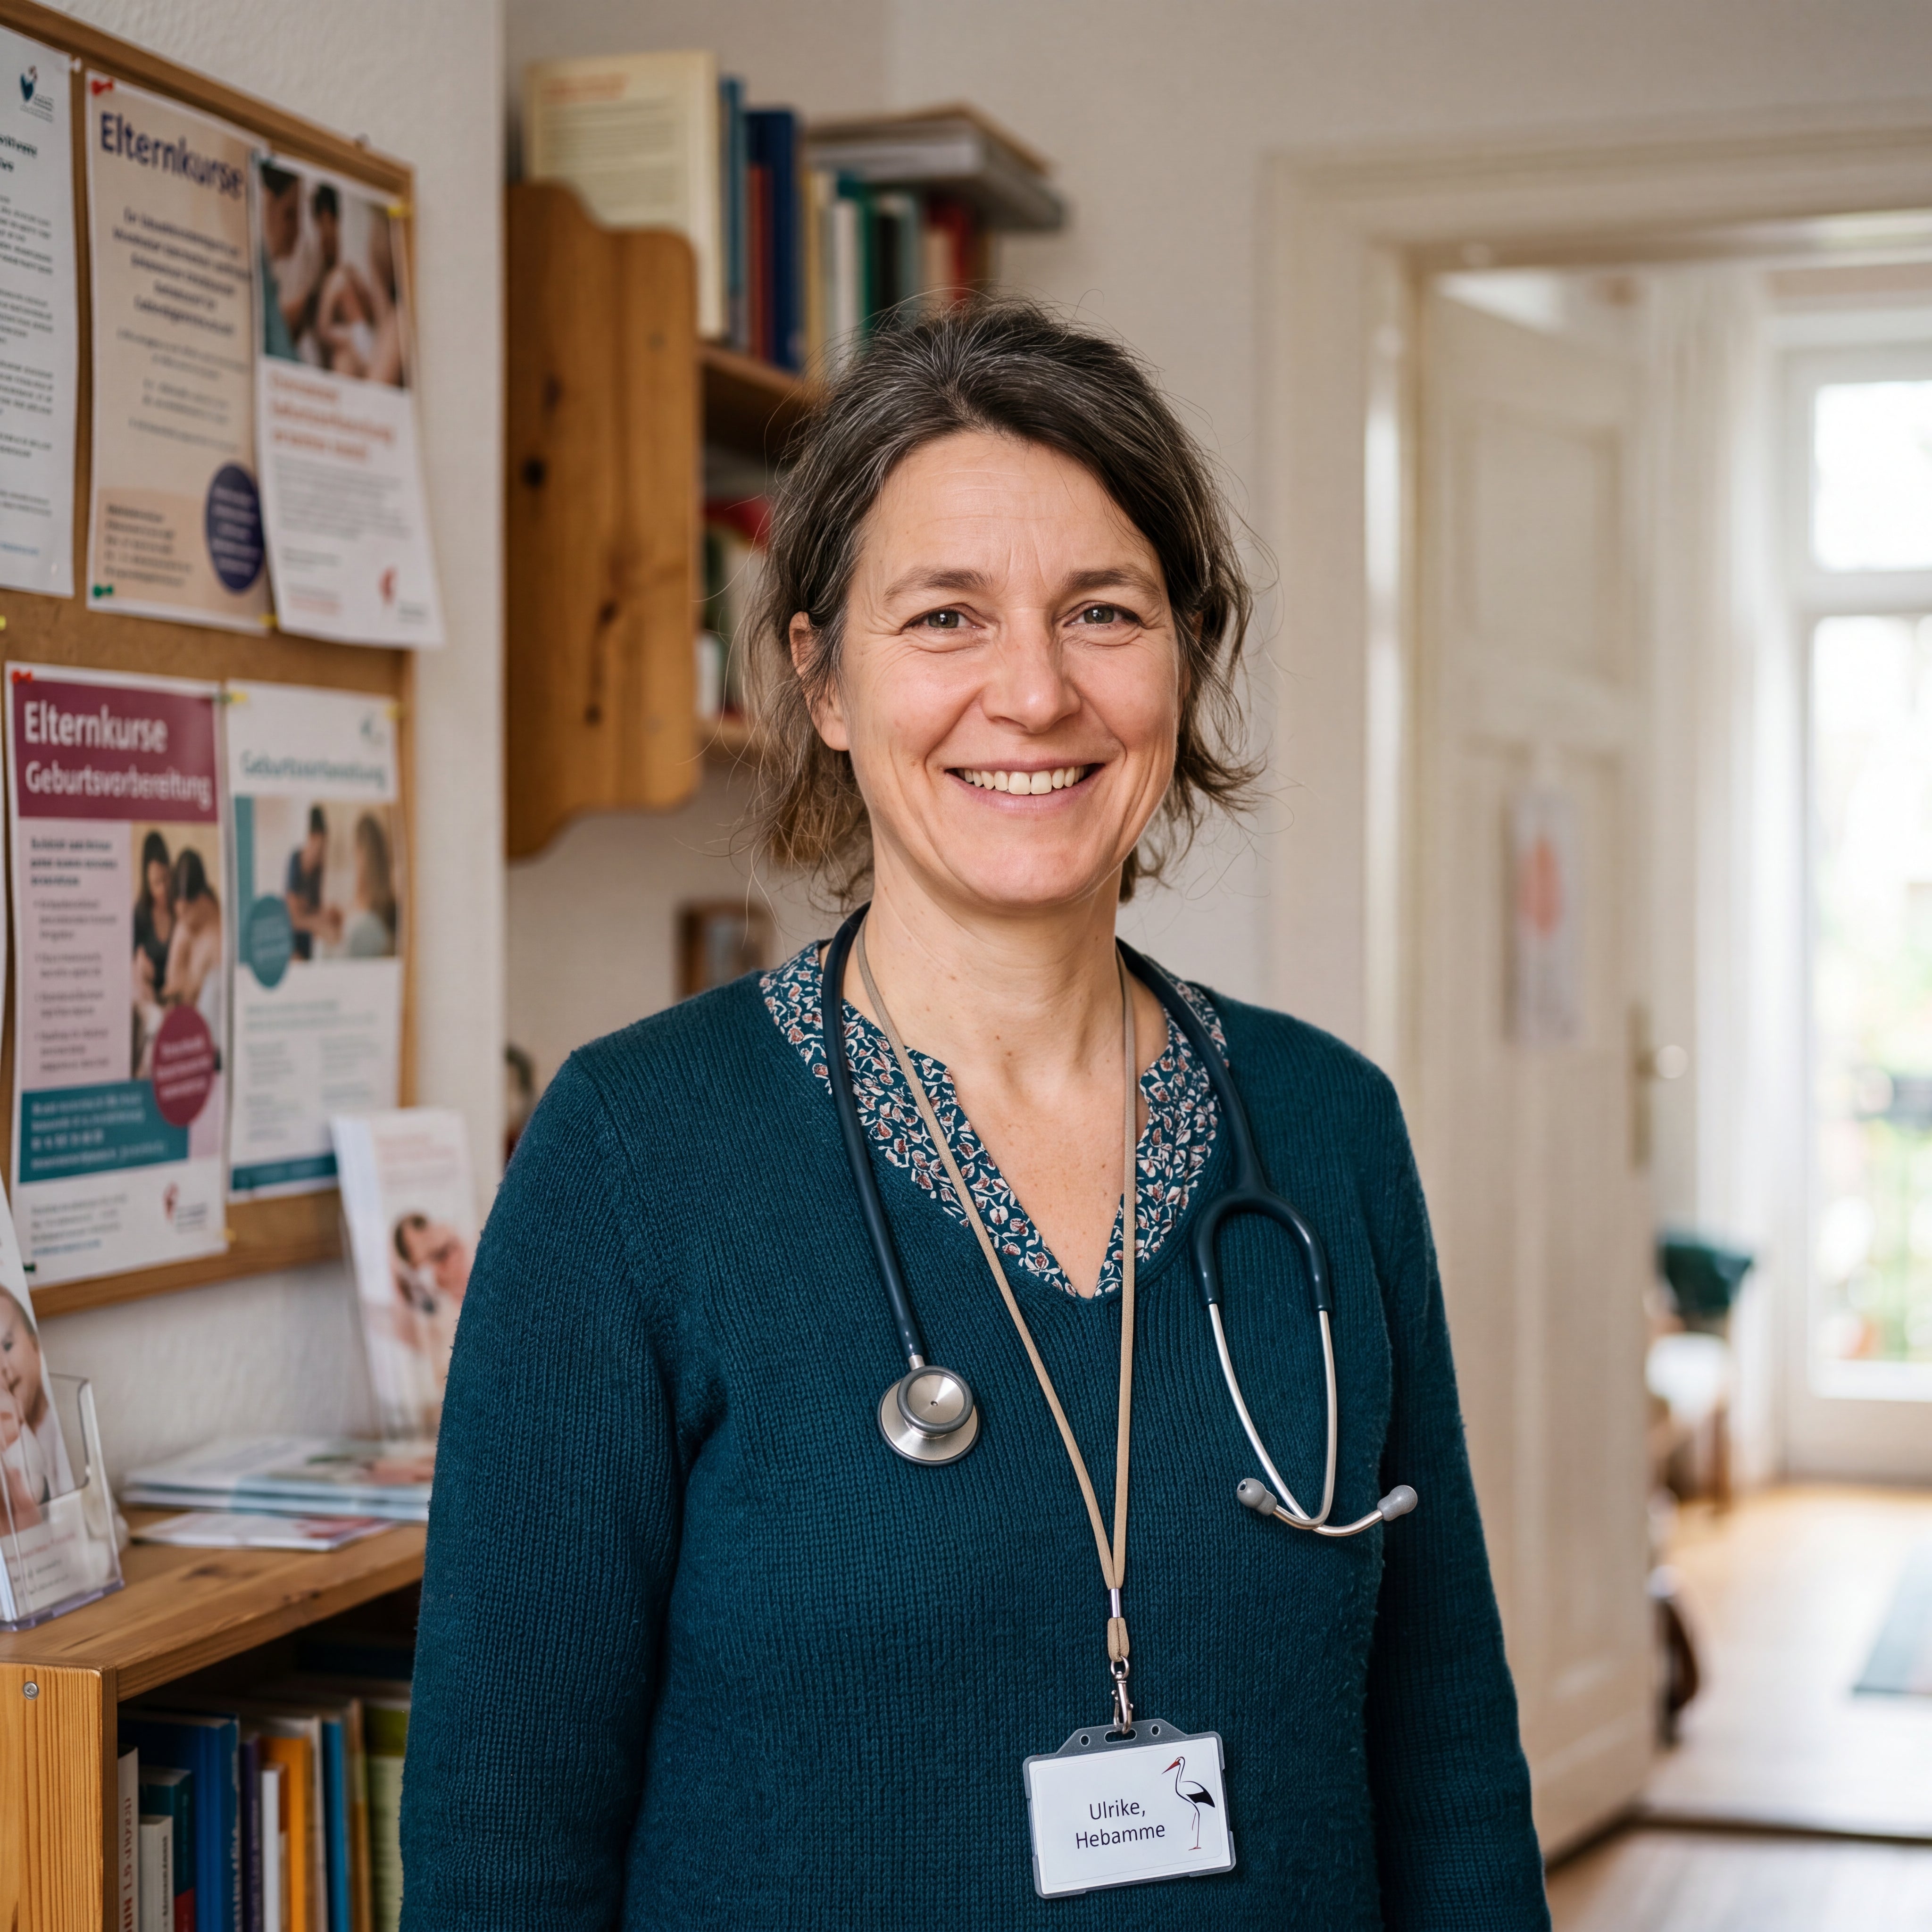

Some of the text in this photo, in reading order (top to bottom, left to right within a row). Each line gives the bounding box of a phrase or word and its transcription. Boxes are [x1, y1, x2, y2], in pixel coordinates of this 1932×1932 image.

[100, 111, 242, 199] Elternkurse
[25, 701, 167, 753] Elternkurse
[25, 759, 212, 811] Geburtsvorbereitung
[1090, 1799, 1145, 1820] Ulrike,
[1076, 1825, 1165, 1849] Hebamme
